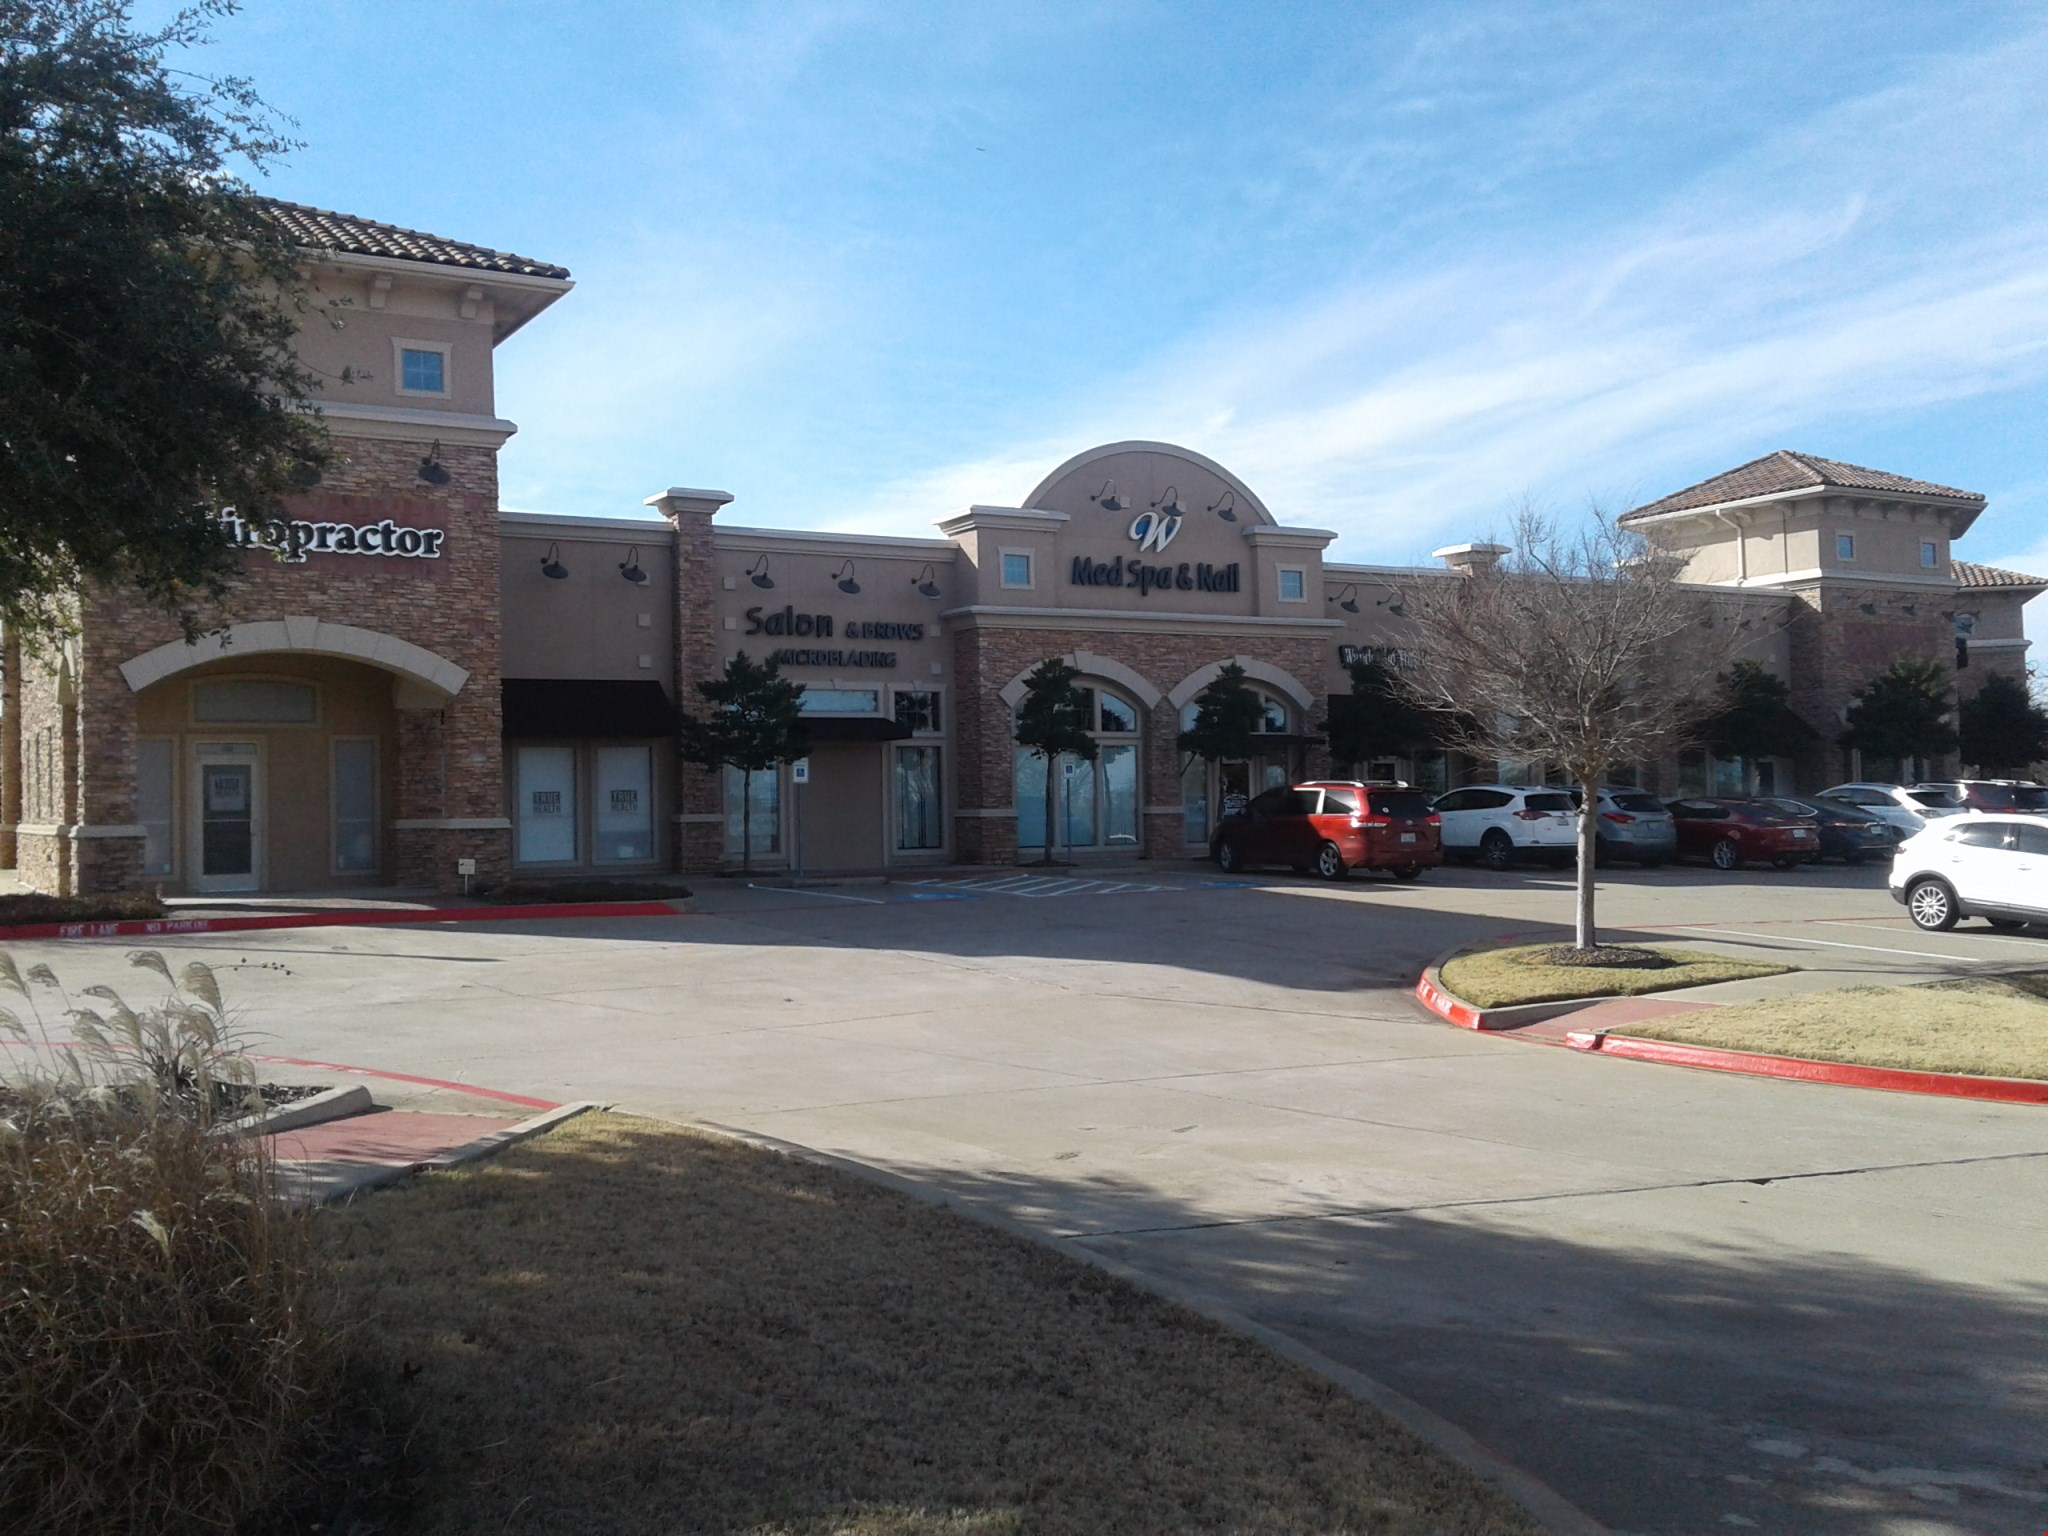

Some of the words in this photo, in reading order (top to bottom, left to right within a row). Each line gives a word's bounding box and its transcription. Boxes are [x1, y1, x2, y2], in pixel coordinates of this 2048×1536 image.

[1130, 511, 1183, 553] W
[1072, 555, 1123, 588] Med
[1126, 559, 1173, 597] Spa
[1177, 562, 1193, 591] &
[745, 605, 833, 638] Salon
[777, 648, 897, 668] MICROBLADING
[534, 792, 560, 803] TRUE
[612, 791, 637, 801] TRUE
[59, 925, 85, 937] FIRE
